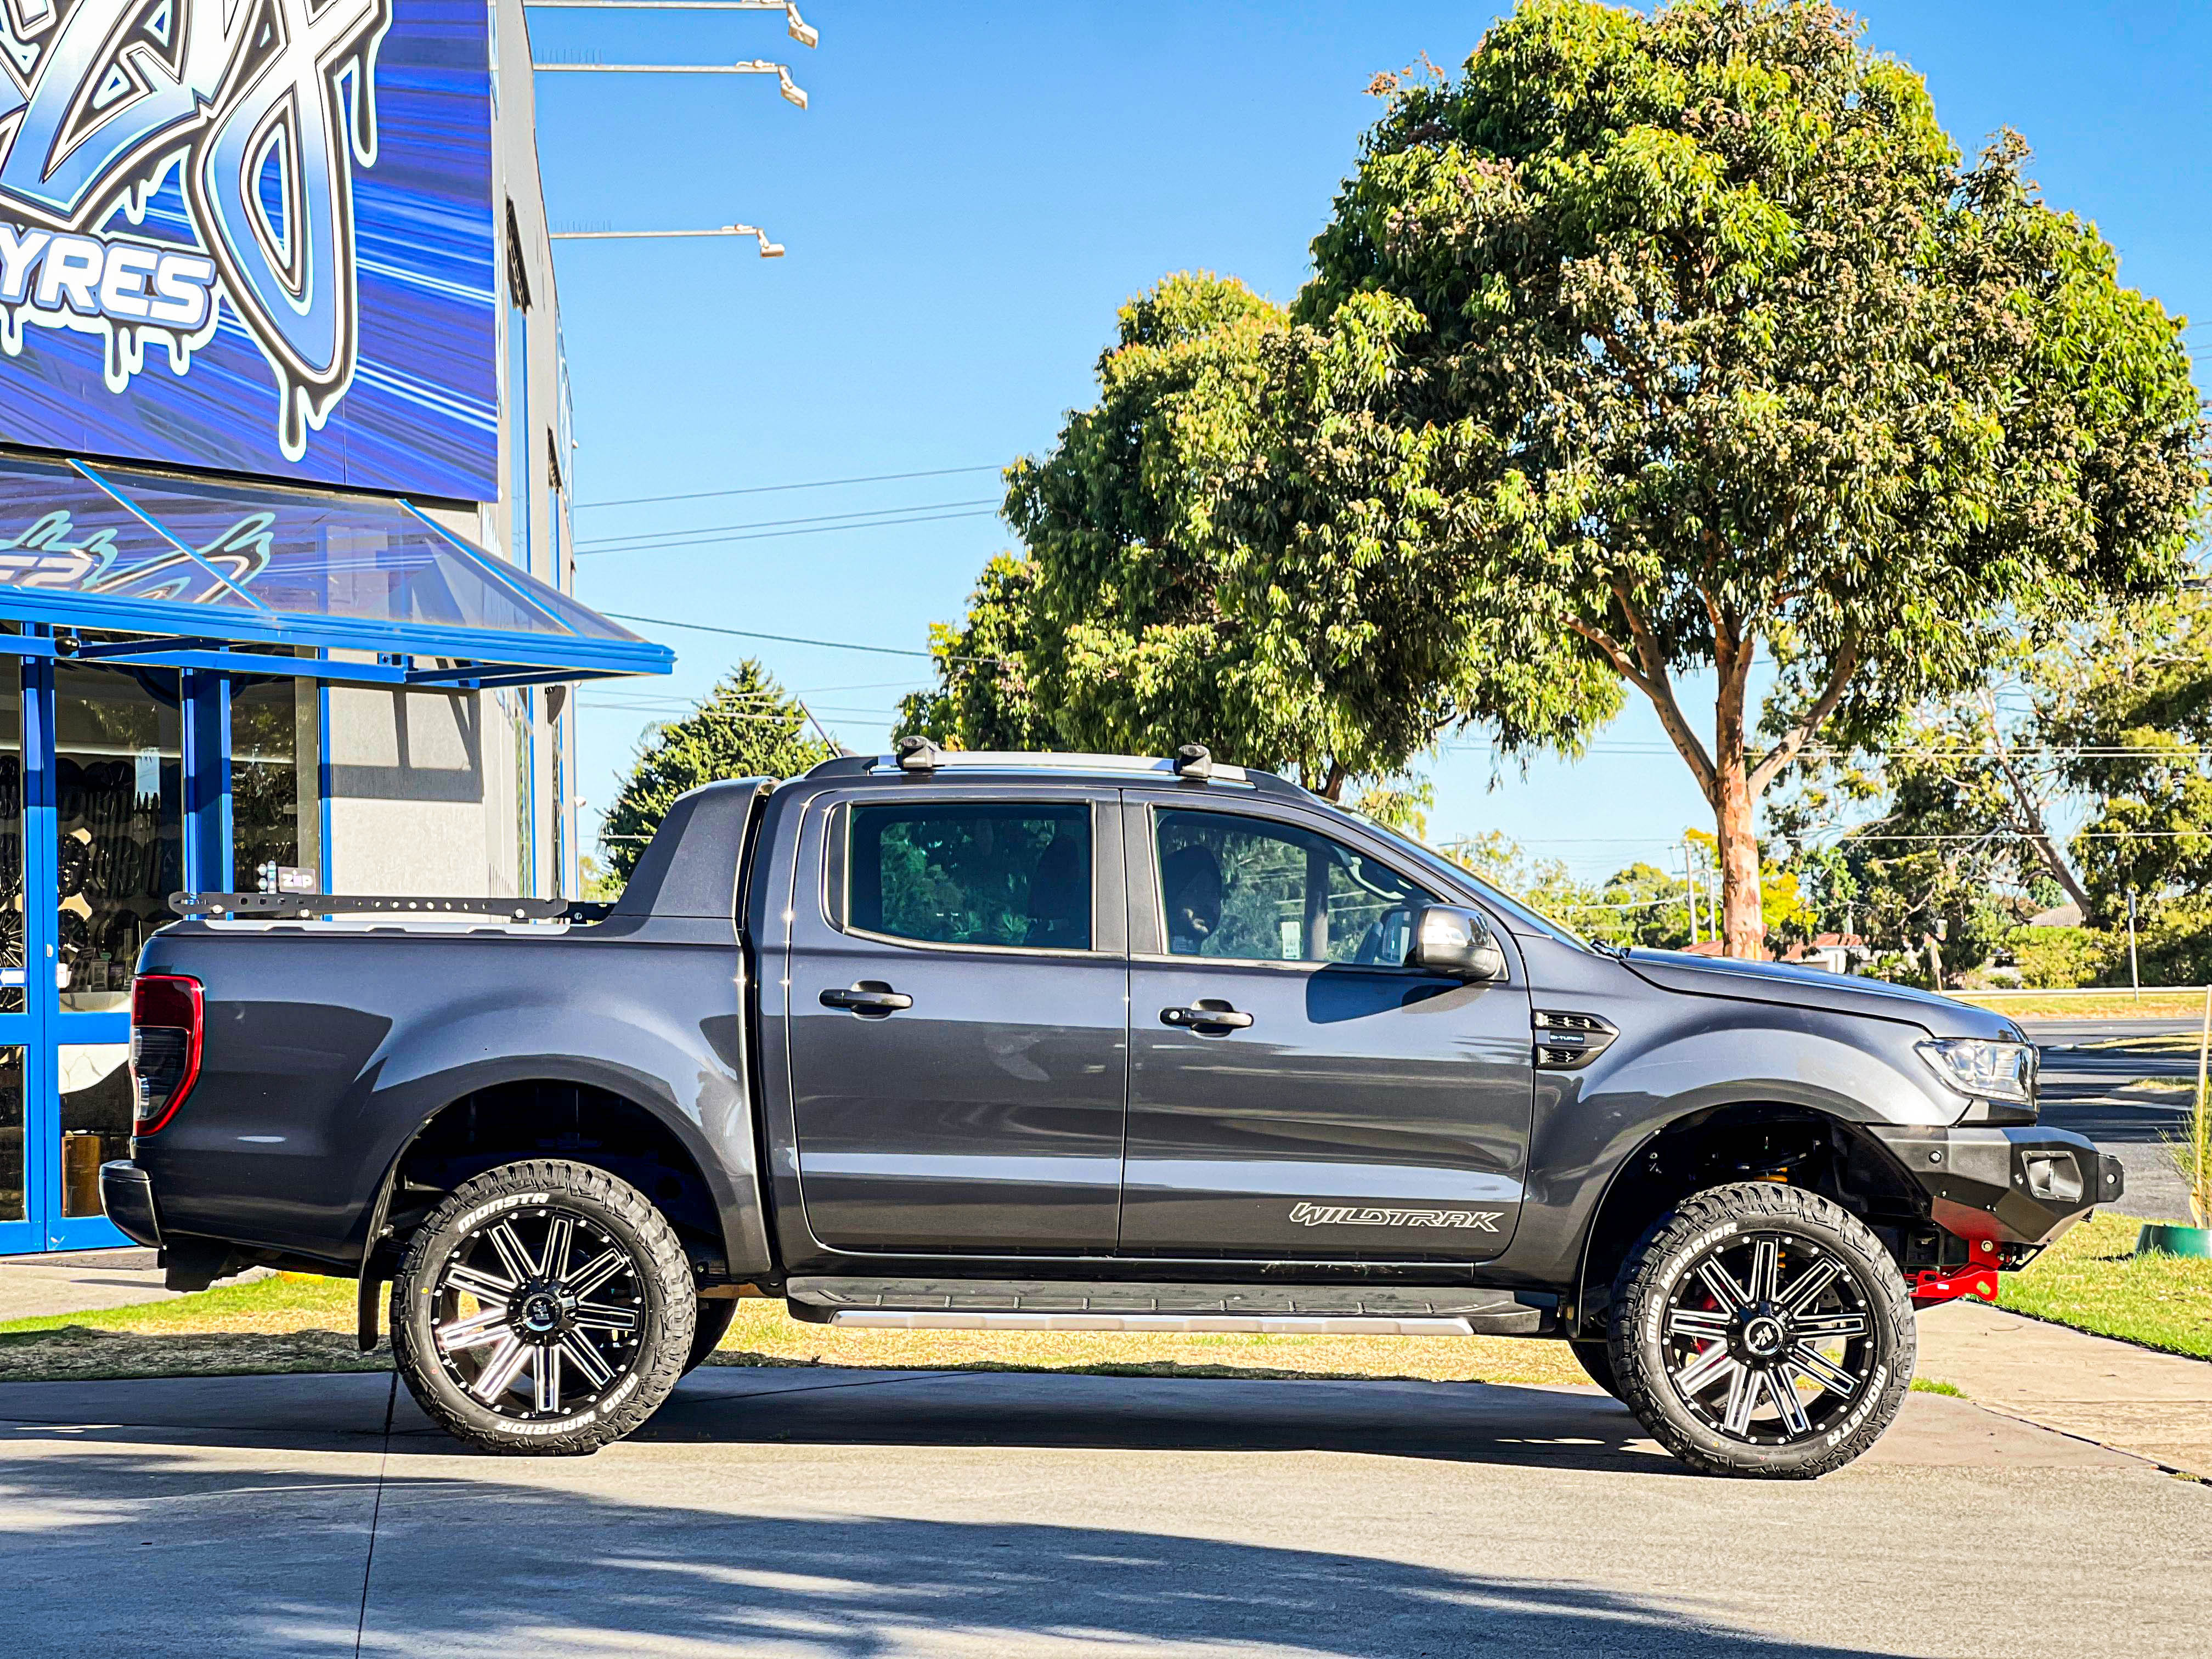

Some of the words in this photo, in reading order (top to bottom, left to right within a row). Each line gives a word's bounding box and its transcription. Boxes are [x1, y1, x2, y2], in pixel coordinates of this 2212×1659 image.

[0, 225, 212, 325] YRES
[458, 1193, 550, 1234] MONSTA
[1289, 1202, 1504, 1232] WILDTRAK
[1646, 1294, 1662, 1344] MUD
[1660, 1222, 1737, 1290] WARRIOR
[602, 1372, 639, 1413] MUD
[1827, 1364, 1887, 1447] MONSTA
[495, 1410, 596, 1435] WARRIOR
